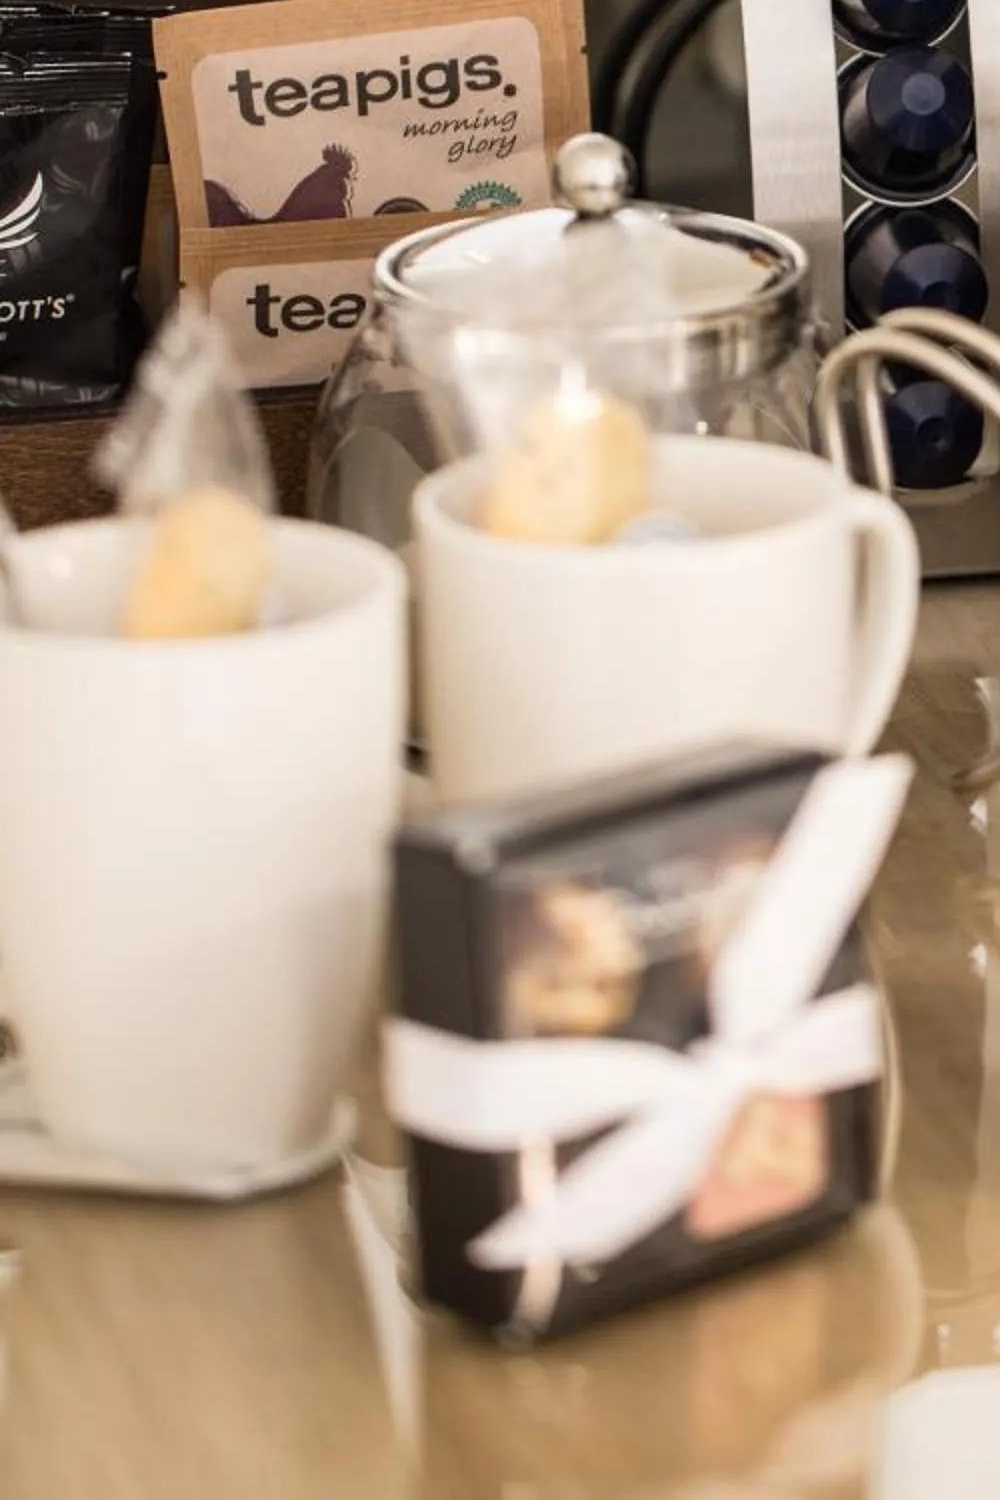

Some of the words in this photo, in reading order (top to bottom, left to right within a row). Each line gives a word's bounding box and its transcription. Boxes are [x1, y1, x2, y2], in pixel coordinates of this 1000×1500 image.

[228, 54, 517, 125] teapigs.
[403, 107, 518, 138] morning
[448, 133, 518, 163] glory
